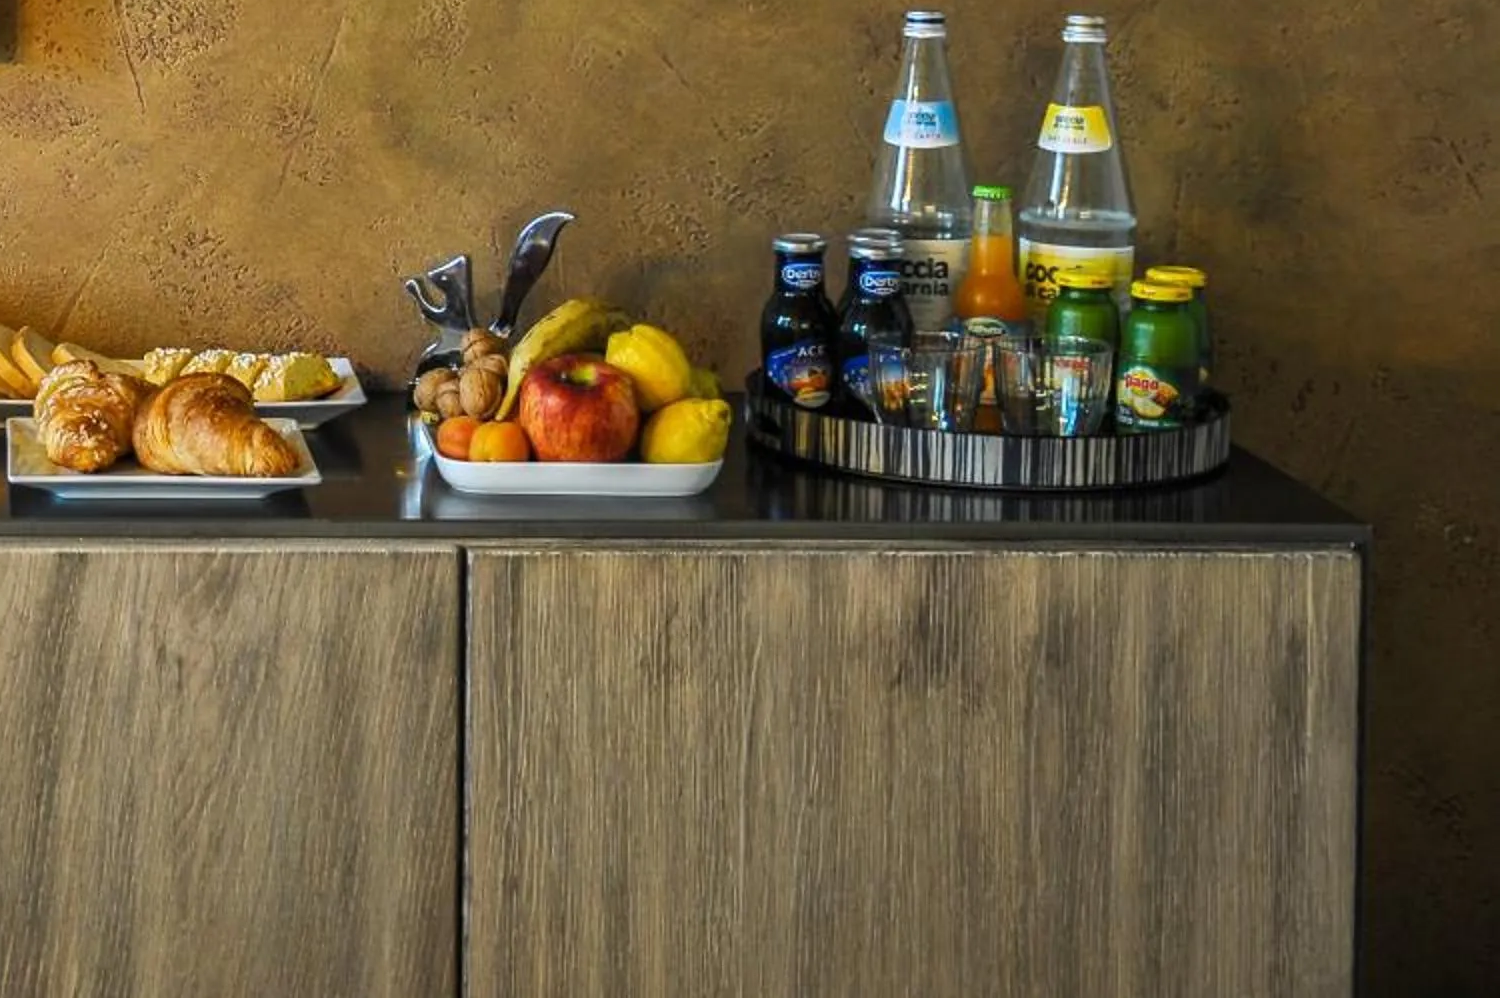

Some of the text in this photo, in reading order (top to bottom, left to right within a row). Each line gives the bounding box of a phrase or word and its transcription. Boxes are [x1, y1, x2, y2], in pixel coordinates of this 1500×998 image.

[900, 257, 949, 279] ccia
[1026, 260, 1059, 284] goc
[901, 280, 949, 295] arnia
